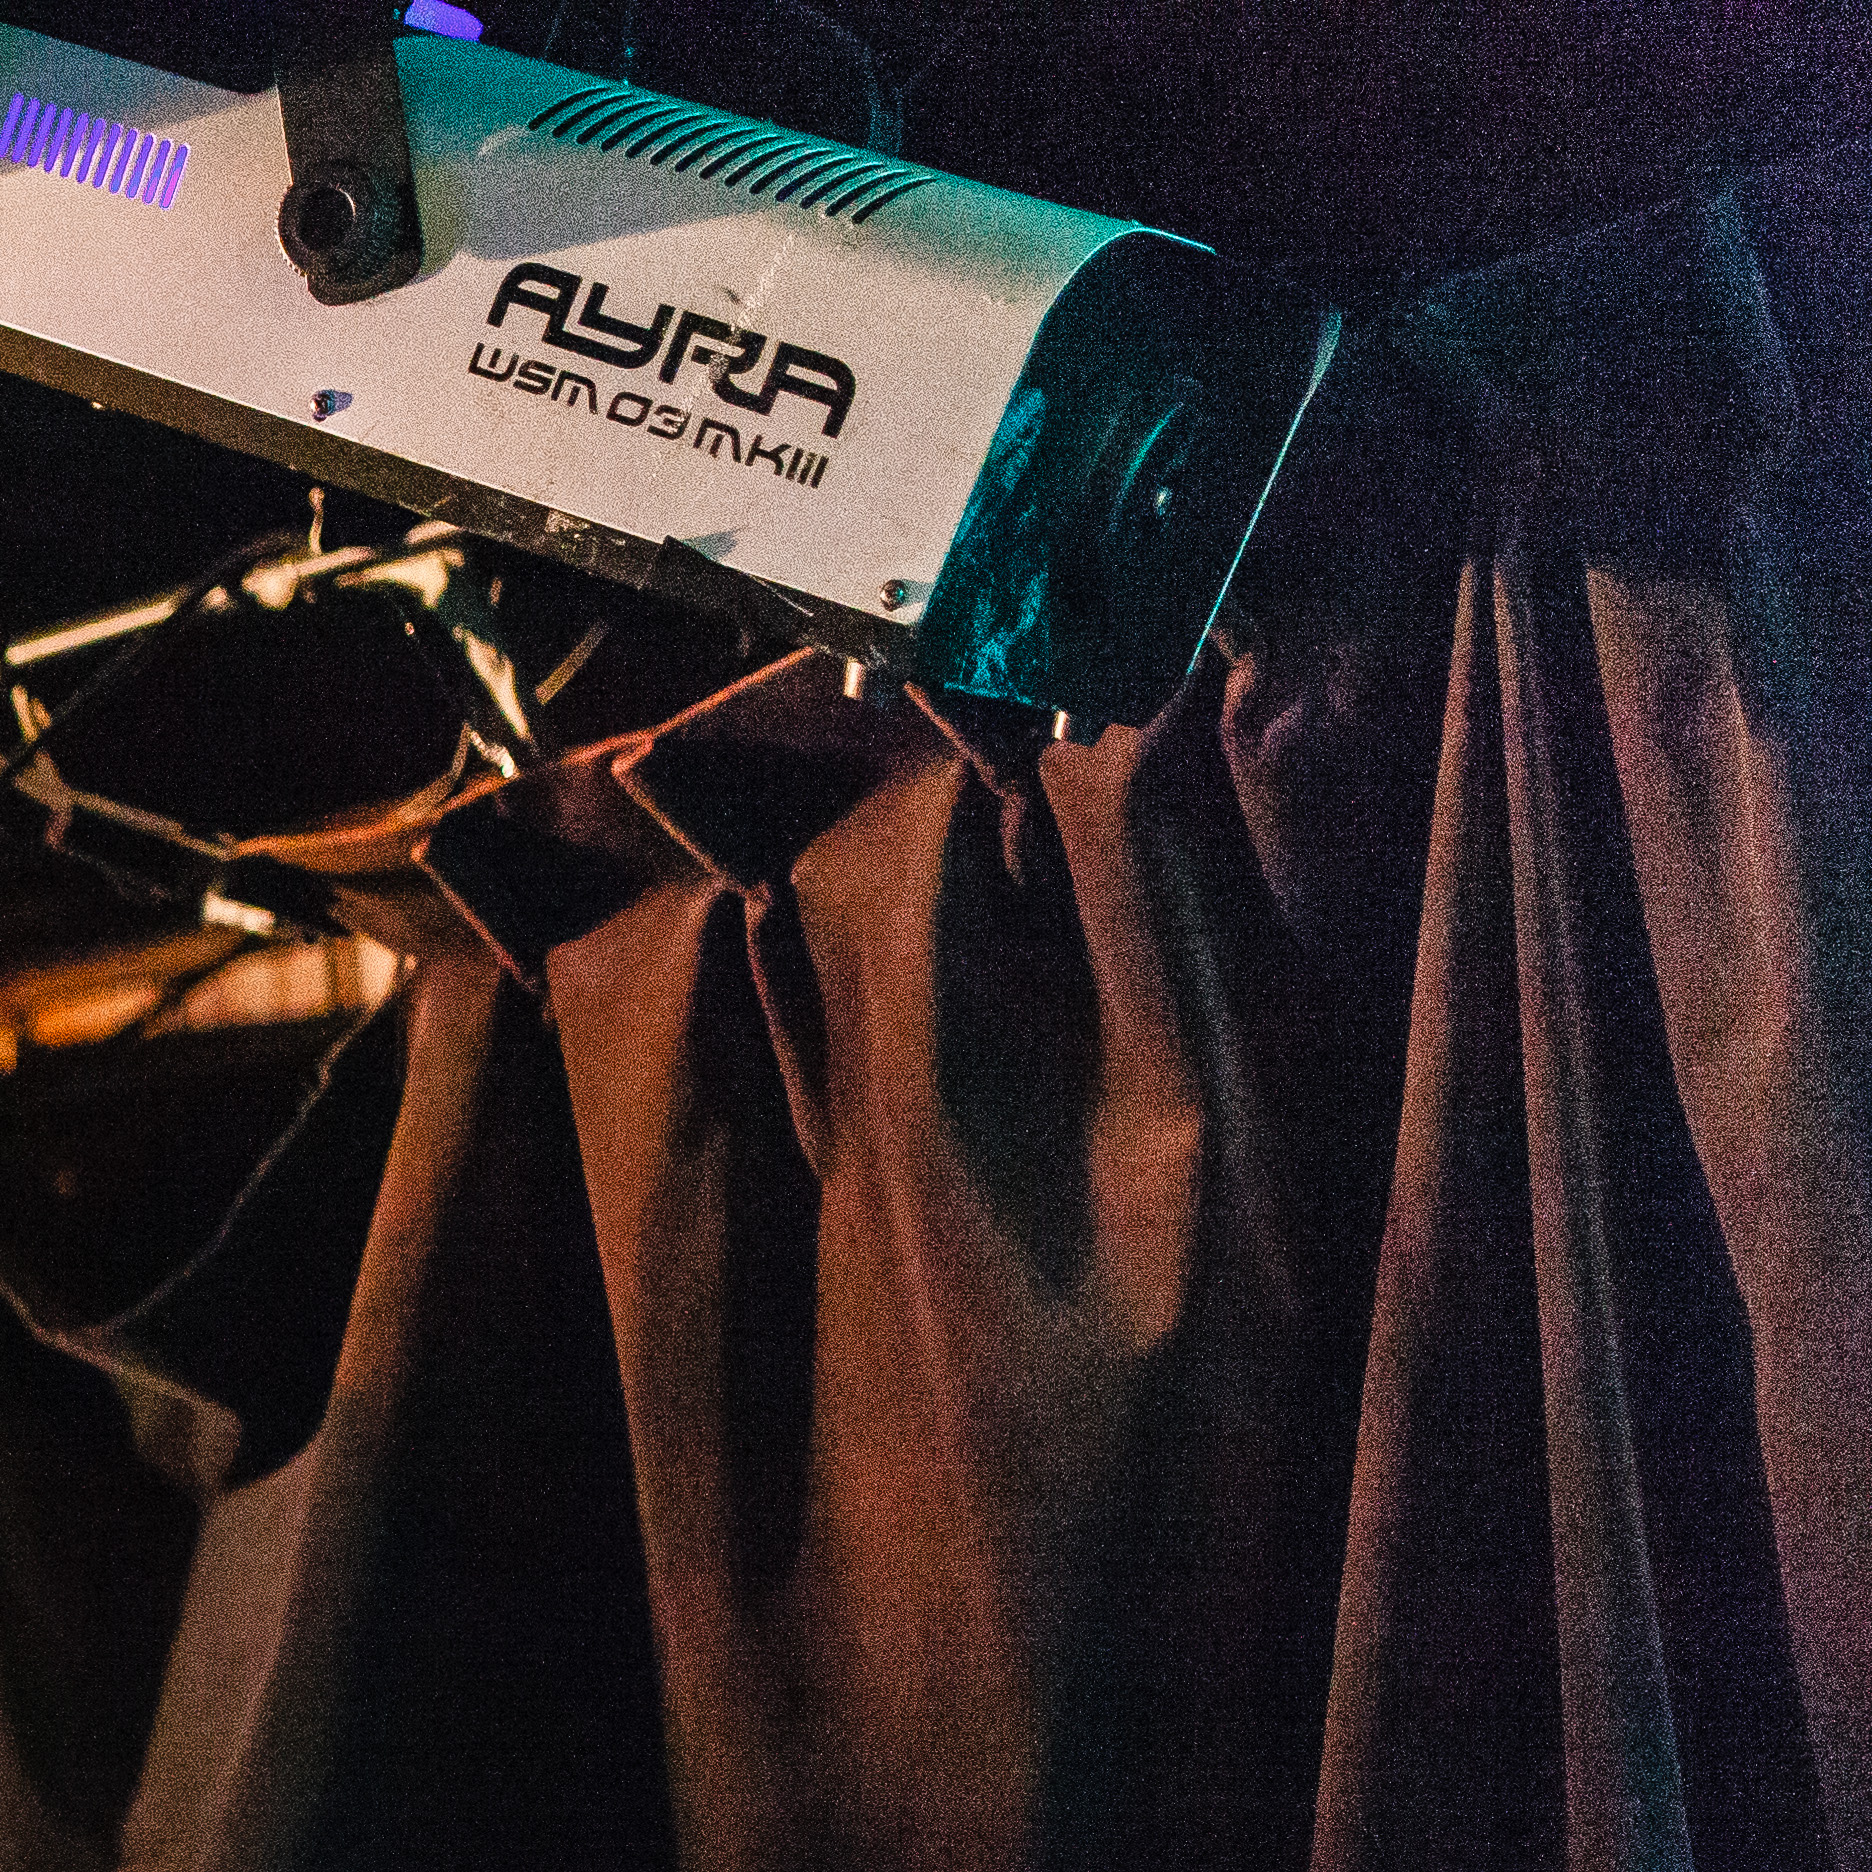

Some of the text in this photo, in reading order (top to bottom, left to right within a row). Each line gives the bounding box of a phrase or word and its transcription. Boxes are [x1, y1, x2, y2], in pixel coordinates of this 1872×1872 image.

[467, 341, 831, 490] WSM 03 MKIII
[487, 261, 857, 439] AYRA
